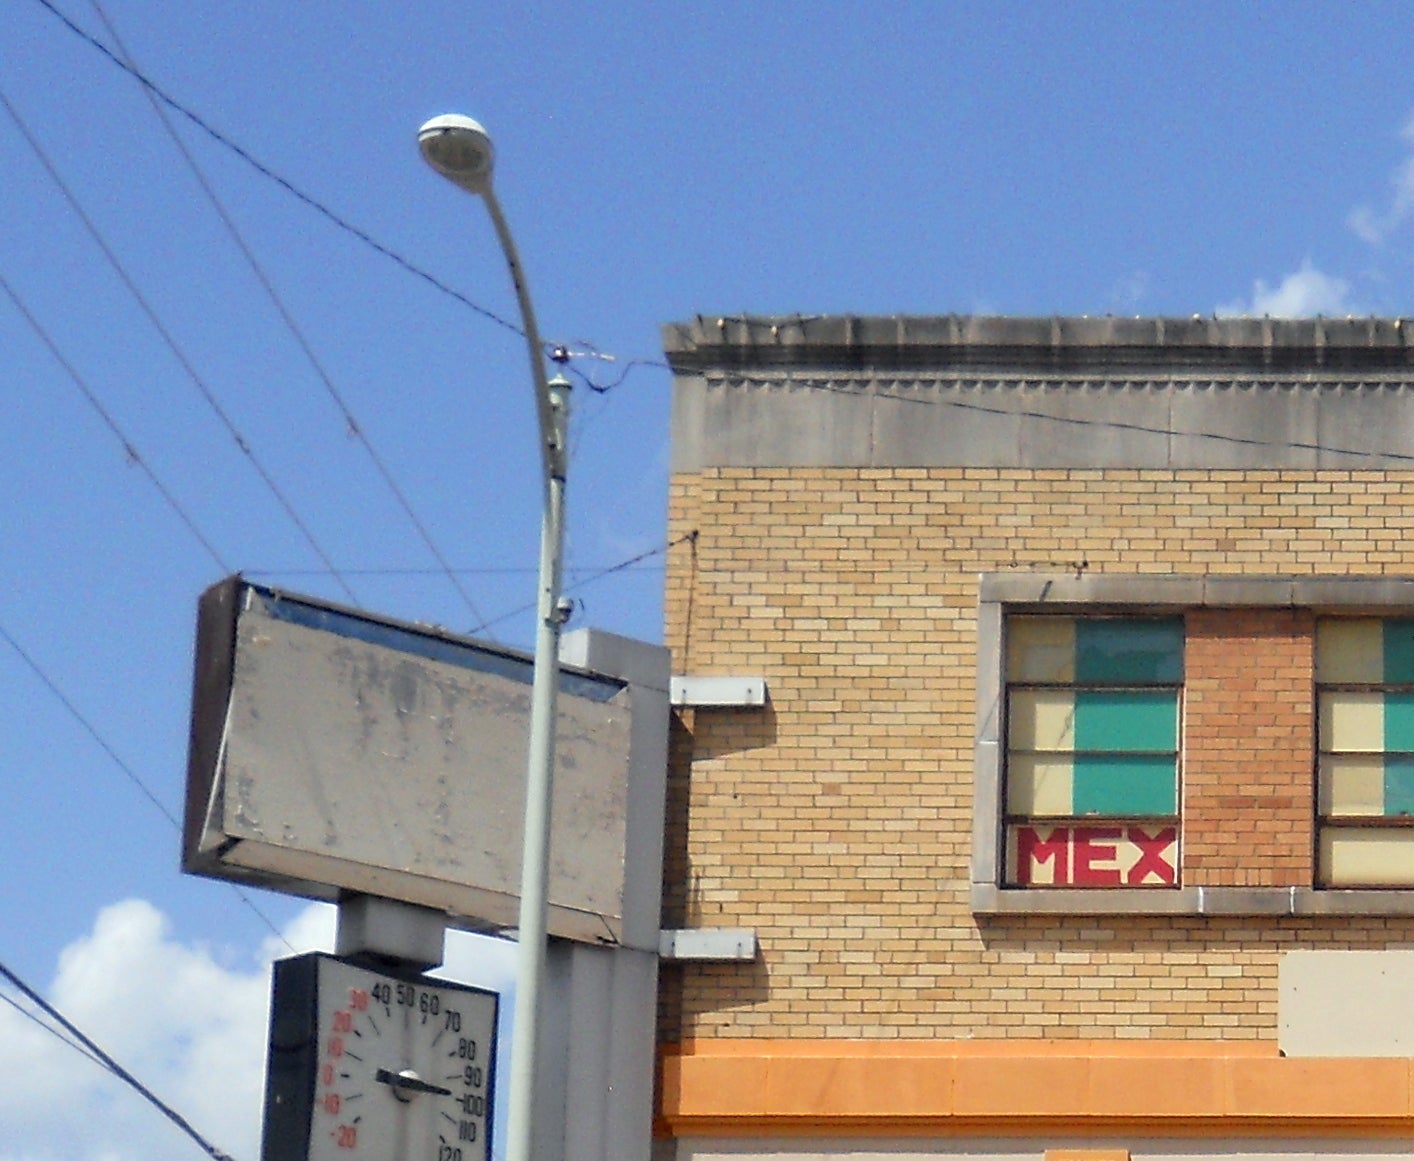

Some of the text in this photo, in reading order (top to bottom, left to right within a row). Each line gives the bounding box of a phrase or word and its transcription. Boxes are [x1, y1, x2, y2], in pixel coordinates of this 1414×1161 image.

[1017, 827, 1176, 884] MEX
[371, 982, 391, 1005] 40
[397, 984, 415, 1007] 50
[420, 992, 439, 1016] 60
[445, 1010, 461, 1033] 70
[459, 1038, 476, 1061] 80
[323, 1063, 333, 1086] 0
[464, 1066, 482, 1088] 90
[463, 1095, 482, 1117] 100
[459, 1122, 477, 1143] 110
